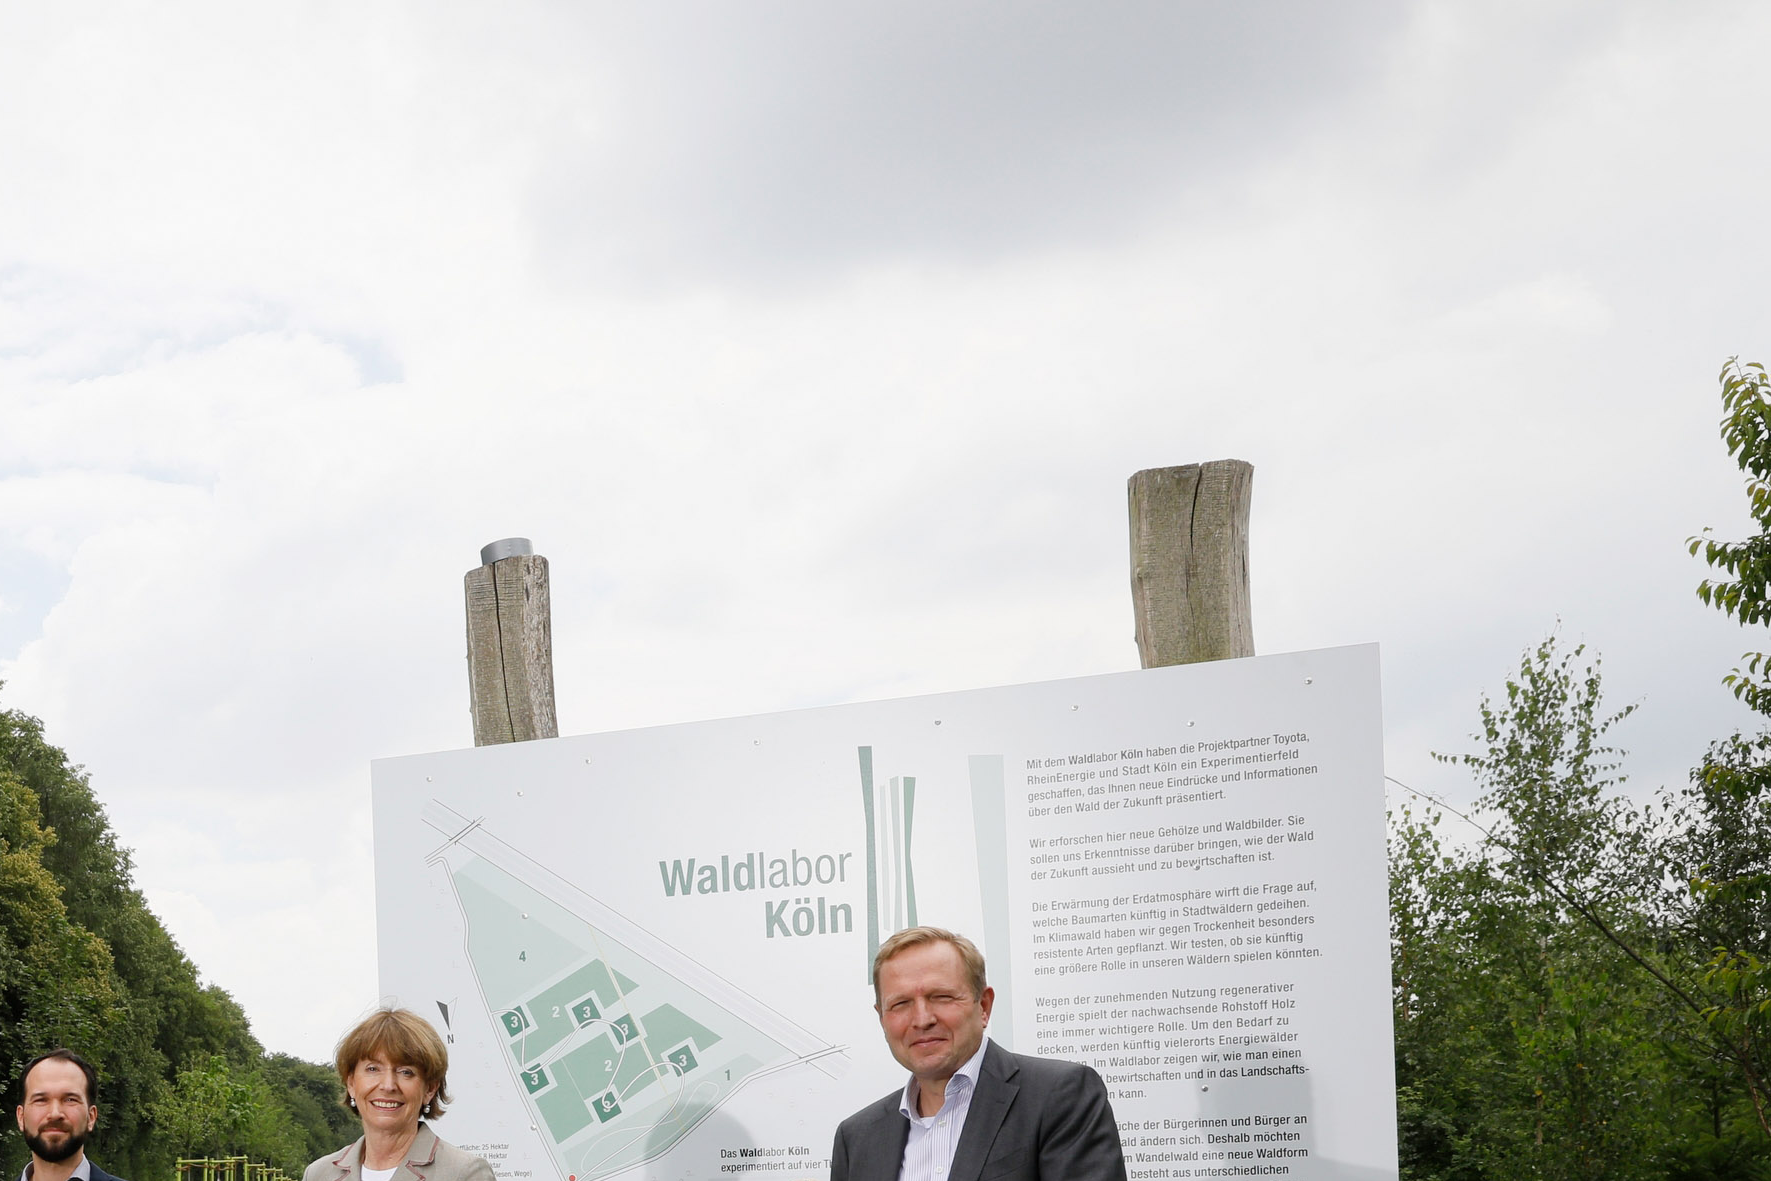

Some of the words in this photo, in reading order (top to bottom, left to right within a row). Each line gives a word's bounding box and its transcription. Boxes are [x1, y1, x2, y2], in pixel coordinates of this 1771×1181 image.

[1026, 758, 1042, 769] Mit
[1043, 757, 1065, 768] dem
[1067, 751, 1118, 765] Waldlabor
[1120, 748, 1143, 760] Köln
[1145, 746, 1177, 757] haben
[1179, 743, 1195, 754] die
[1197, 736, 1271, 753] Projektpartner
[1274, 731, 1309, 746] Toyota,
[1026, 769, 1095, 785] RheinEnergie
[1098, 766, 1118, 779] und
[1121, 763, 1150, 776] Stadt
[1153, 761, 1177, 773] Köln
[1180, 759, 1197, 770] ein
[1200, 748, 1299, 769] Experimentierfeld
[1027, 787, 1085, 803] geschaffen,
[1086, 785, 1105, 795] das
[1107, 783, 1136, 793] Ihnen
[1138, 780, 1164, 791] neue
[1166, 773, 1218, 788] Eindrücke
[1220, 770, 1241, 783] und
[1243, 765, 1318, 780] Informationen
[1028, 806, 1051, 817] über
[1053, 804, 1072, 815] den
[1074, 800, 1100, 812] Wald
[1102, 799, 1120, 810] der
[1122, 794, 1163, 808] Zukunft
[1165, 789, 1226, 806] präsentiert.
[1029, 838, 1046, 848] Wir
[1049, 833, 1103, 847] erforschen
[1106, 831, 1126, 842] hier
[1129, 829, 1154, 840] neue
[1157, 824, 1199, 837] Gehölze
[1202, 821, 1222, 834] und
[1224, 817, 1284, 831] Waldbilder.
[1287, 814, 1305, 826] Sie
[1029, 853, 1059, 864] sollen
[1062, 852, 1081, 862] uns
[1084, 845, 1150, 860] Erkenntnisse
[1153, 841, 1194, 854] darüber
[1197, 838, 1241, 851] bringen,
[1243, 834, 1263, 846] wie
[1266, 833, 1284, 844] der
[1286, 830, 1314, 842] Wald
[659, 849, 852, 897] Waldlabor
[1030, 870, 1047, 880] der
[1049, 865, 1088, 879] Zukunft
[1091, 862, 1135, 875] aussieht
[1137, 860, 1157, 871] und
[1159, 860, 1172, 870] zu
[1175, 852, 1255, 870] bewirtschaften
[1257, 850, 1274, 861] ist.
[1032, 901, 1048, 912] Die
[1051, 898, 1109, 911] Erwärmung
[1112, 895, 1129, 906] der
[1132, 888, 1211, 904] Erdatmosphäre
[1214, 886, 1240, 898] wirft
[1242, 884, 1259, 896] die
[1262, 883, 1293, 895] Frage
[1296, 879, 1316, 892] auf,
[765, 897, 854, 939] Köln
[1032, 916, 1068, 927] welche
[1071, 912, 1127, 925] Baumarten
[1129, 908, 1166, 921] künftig
[1169, 907, 1179, 917] in
[1181, 902, 1253, 917] Stadtwäldern
[1256, 898, 1309, 914] gedeihen.
[519, 951, 526, 962] 4
[1035, 997, 1070, 1008] Wegen
[1073, 995, 1090, 1005] der
[1093, 990, 1168, 1004] zunehmenden
[1171, 988, 1216, 999] Nutzung
[1219, 982, 1294, 998] regenerativer
[552, 1006, 560, 1018] 2
[583, 1007, 591, 1018] 3
[1036, 1011, 1075, 1024] Energie
[1078, 1009, 1107, 1022] spielt
[1110, 1008, 1128, 1019] der
[1131, 1002, 1218, 1018] nachwachsende
[1221, 999, 1268, 1012] Rohstoff
[1271, 997, 1295, 1009] Holz
[510, 1016, 519, 1028] 3
[621, 1024, 629, 1035] 3
[447, 1034, 454, 1044] N
[604, 1060, 613, 1072] 2
[679, 1055, 687, 1067] 3
[531, 1074, 539, 1085] 3
[725, 1069, 731, 1081] 1
[720, 1149, 737, 1158] Das
[739, 1148, 786, 1158] Waldlabor
[788, 1146, 810, 1156] Köln
[1135, 1150, 1198, 1163] Wandelwald
[1201, 1150, 1224, 1160] eine
[1227, 1150, 1254, 1160] neue
[1255, 1147, 1308, 1159] Waldform
[514, 1170, 532, 1178] Wege)
[721, 1161, 785, 1173] experimentiert
[788, 1160, 802, 1170] auf
[805, 1160, 821, 1169] vier
[1130, 1168, 1169, 1179] besteht
[1172, 1168, 1191, 1178] aus
[1193, 1164, 1289, 1177] unterschiedlichen
